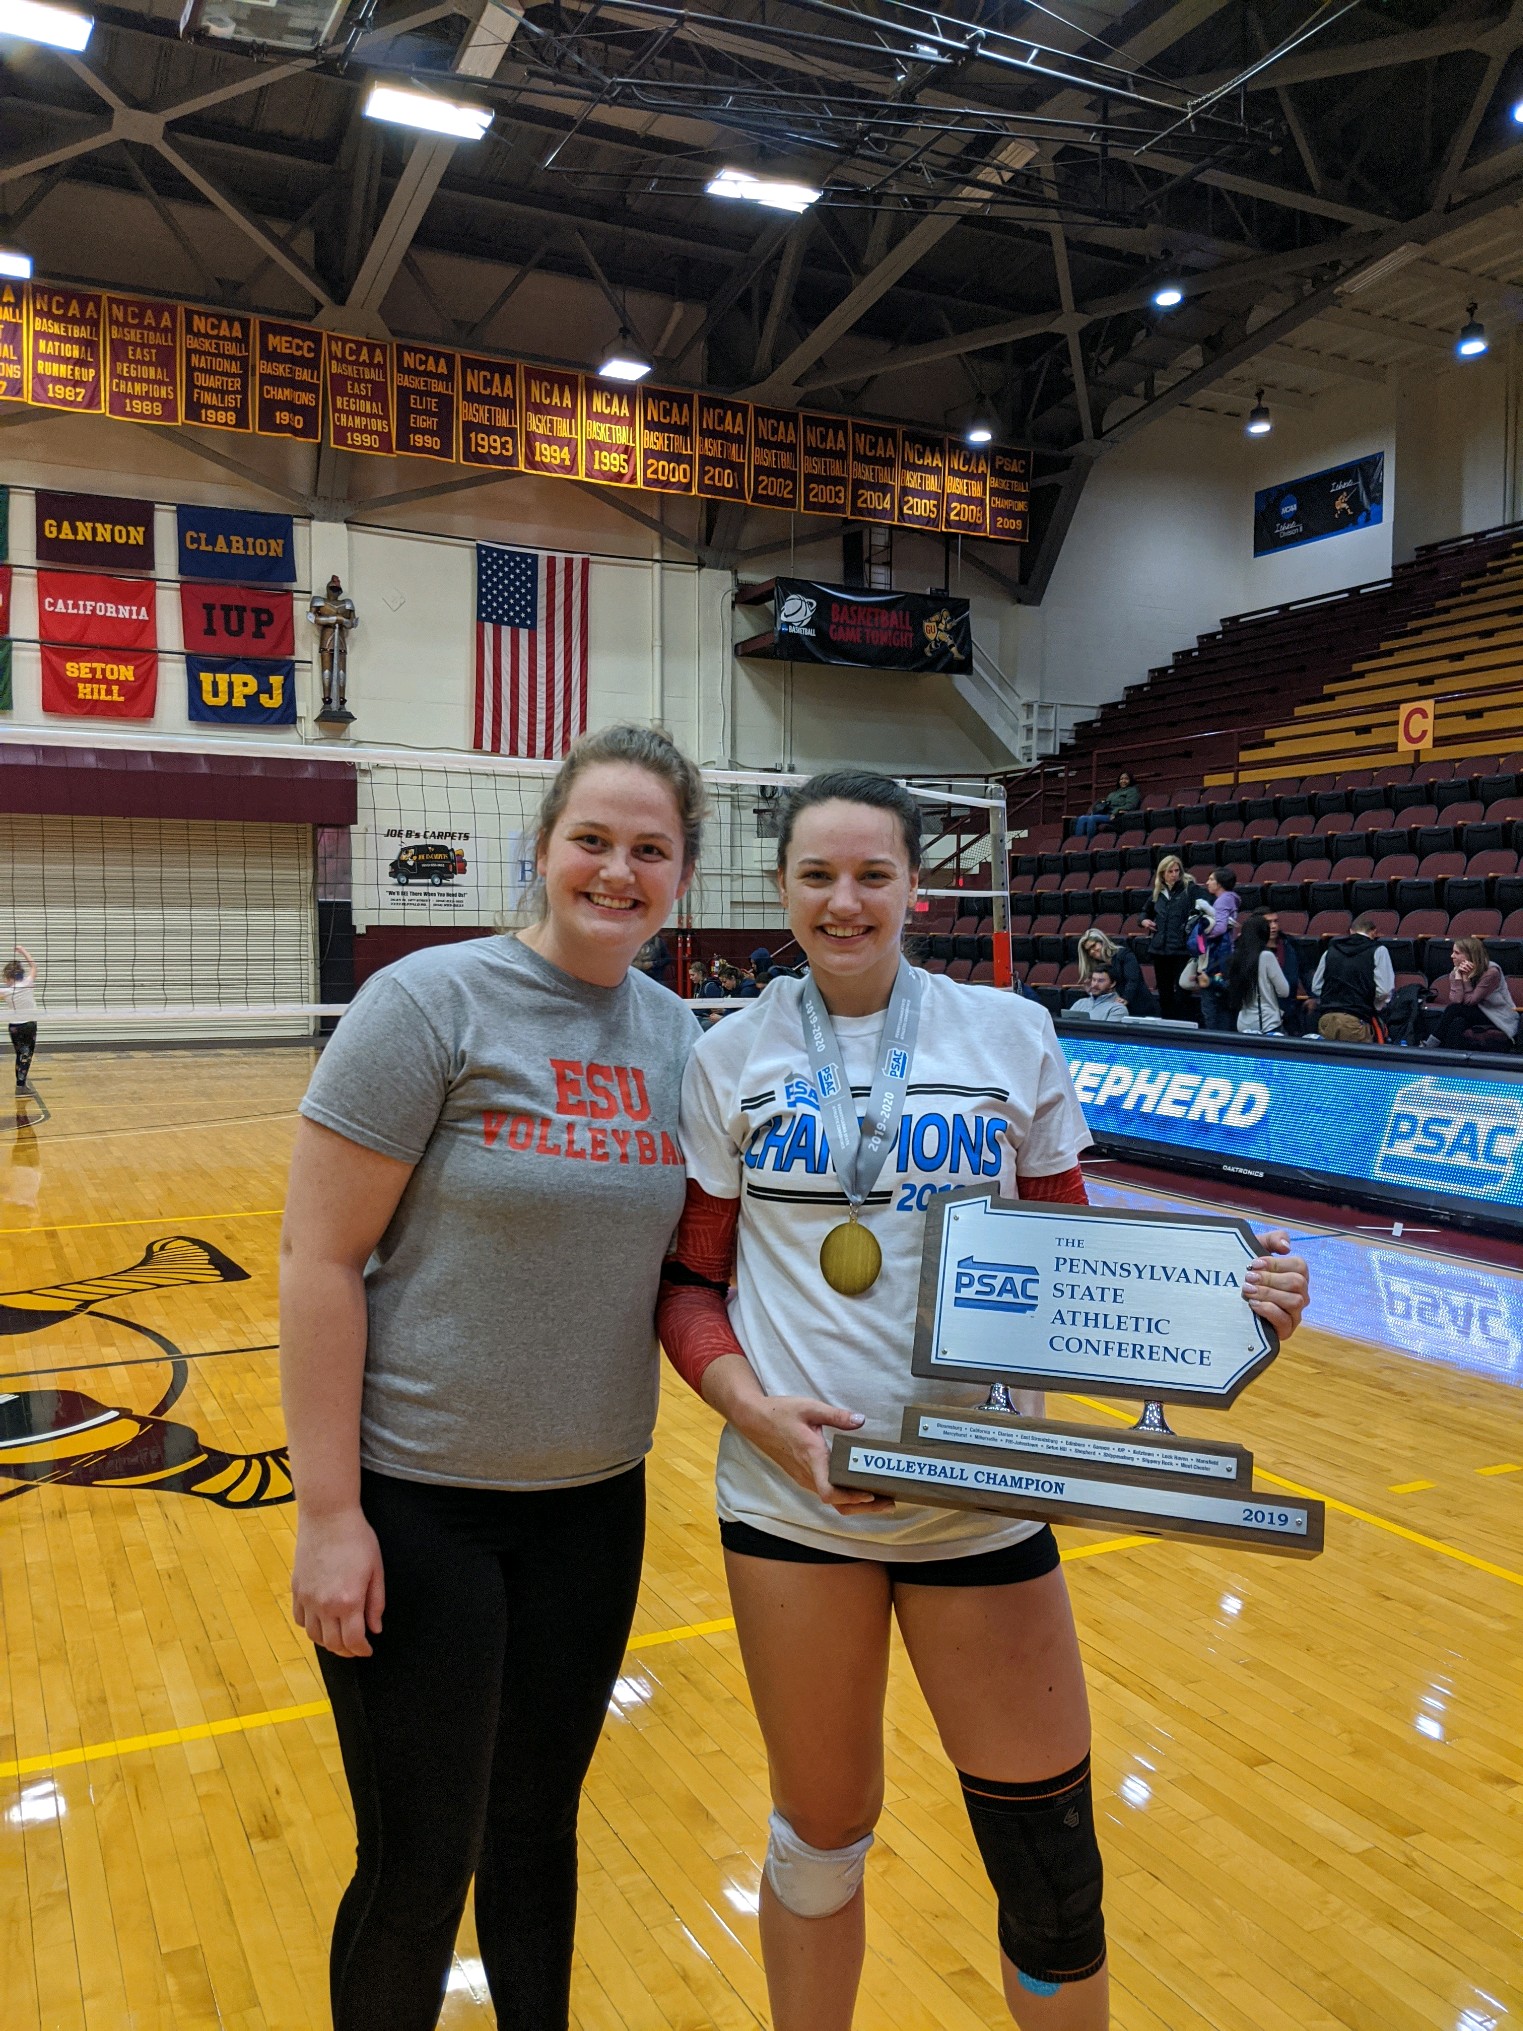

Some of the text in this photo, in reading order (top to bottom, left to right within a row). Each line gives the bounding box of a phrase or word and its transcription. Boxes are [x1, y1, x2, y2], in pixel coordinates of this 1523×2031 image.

[36, 293, 98, 319] NCAA
[112, 303, 172, 329] NCAA
[35, 317, 98, 340] BASKETBALL
[111, 325, 173, 346] BASKETBALL
[192, 314, 242, 339] NCAA
[39, 339, 93, 361] NATIONAL
[128, 346, 157, 361] EAST
[186, 335, 248, 356] BASKETBALL
[268, 334, 315, 358] MECC
[331, 340, 384, 364] NCAA
[38, 360, 95, 382] RUNNERUP
[117, 362, 169, 381] REGIONAL
[191, 354, 243, 374] NATIONAL
[331, 360, 386, 382] BASKETBALL
[403, 351, 448, 375] NCAA
[47, 383, 86, 401] 1987
[113, 379, 174, 399] CHAMPIONS
[193, 372, 241, 390] QUARTER
[347, 381, 373, 397] EAST
[397, 373, 454, 395] BASKETBALL
[466, 368, 514, 399] NCAA
[193, 389, 242, 409] FINALIST
[264, 386, 316, 407] CHAMIONS
[336, 396, 384, 415] REGIONAL
[410, 394, 439, 412] ELITE
[531, 379, 572, 409] NCAA
[592, 388, 630, 417] NCAA
[125, 399, 162, 416] 1988
[200, 408, 237, 425] 1988
[462, 401, 518, 428] BASKETBALL
[647, 397, 690, 427] NCAA
[334, 413, 389, 433] CHAMPIONS
[410, 414, 439, 431] EIGHT
[527, 411, 578, 439] BASKETBALL
[586, 419, 636, 447] BASKETBALL
[702, 406, 744, 435] NCAA
[757, 416, 796, 444] NCAA
[346, 432, 380, 448] 1990
[409, 433, 441, 450] 1990
[469, 431, 513, 457] 1993
[643, 429, 694, 455] BASKETBALL
[699, 436, 745, 463] BASKETBALL
[806, 424, 846, 451] NCAA
[854, 432, 896, 459] NCAA
[534, 441, 571, 466] 1994
[593, 449, 629, 474] 1995
[754, 446, 798, 471] BASKETBALL
[904, 440, 943, 467] NCAA
[949, 448, 987, 474] NCAA
[995, 455, 1026, 474] PSAC
[646, 458, 690, 483] 2000
[704, 465, 739, 490] 2001
[804, 455, 848, 478] BASKETBALL
[852, 460, 896, 485] BASKETBALL
[757, 475, 794, 499] 2002
[900, 468, 942, 493] BASKETBALL
[989, 476, 1030, 493] BASKETBALL
[809, 483, 845, 504] 2003
[857, 489, 891, 511] 2004
[990, 496, 1029, 512] CHAMPIONS
[903, 496, 938, 518] 2005
[44, 519, 146, 546] GANNON
[996, 516, 1023, 531] 2009
[185, 530, 285, 558] CLARION
[44, 597, 149, 621] CALIFORNIA
[202, 603, 275, 640] IUP
[831, 602, 912, 631] BASKETBALL
[788, 624, 816, 637] BASKETBALL
[828, 624, 915, 649] GAME TONIGHT
[65, 662, 136, 682] SETON
[77, 683, 125, 702] HILL
[199, 672, 285, 709] UPJ
[1403, 707, 1428, 744] C
[383, 828, 470, 841] JOE B's CARPETS
[805, 1000, 826, 1053] 2019-2020
[889, 1050, 903, 1078] PSAC
[549, 1058, 651, 1122] ESU
[785, 1081, 819, 1103] PSA
[821, 1066, 836, 1096] PSAC
[1068, 1060, 1271, 1128] EPHERD
[868, 1091, 894, 1152] 2019-2020
[482, 1110, 685, 1166] VOLLEYBA
[745, 1112, 1008, 1177] CHAIONS
[1387, 1112, 1517, 1167] PSAC
[1055, 1237, 1085, 1249] THE
[1054, 1256, 1240, 1288] PENNSYLVANIA
[955, 1271, 1040, 1301] PSAC
[1052, 1283, 1125, 1304] STATE
[1050, 1309, 1170, 1335] ATHLETIC
[1049, 1335, 1212, 1367] CONFERENCE
[969, 1427, 991, 1435] California
[863, 1454, 1289, 1527] VOLLEYBALL CHAMPION 2019
